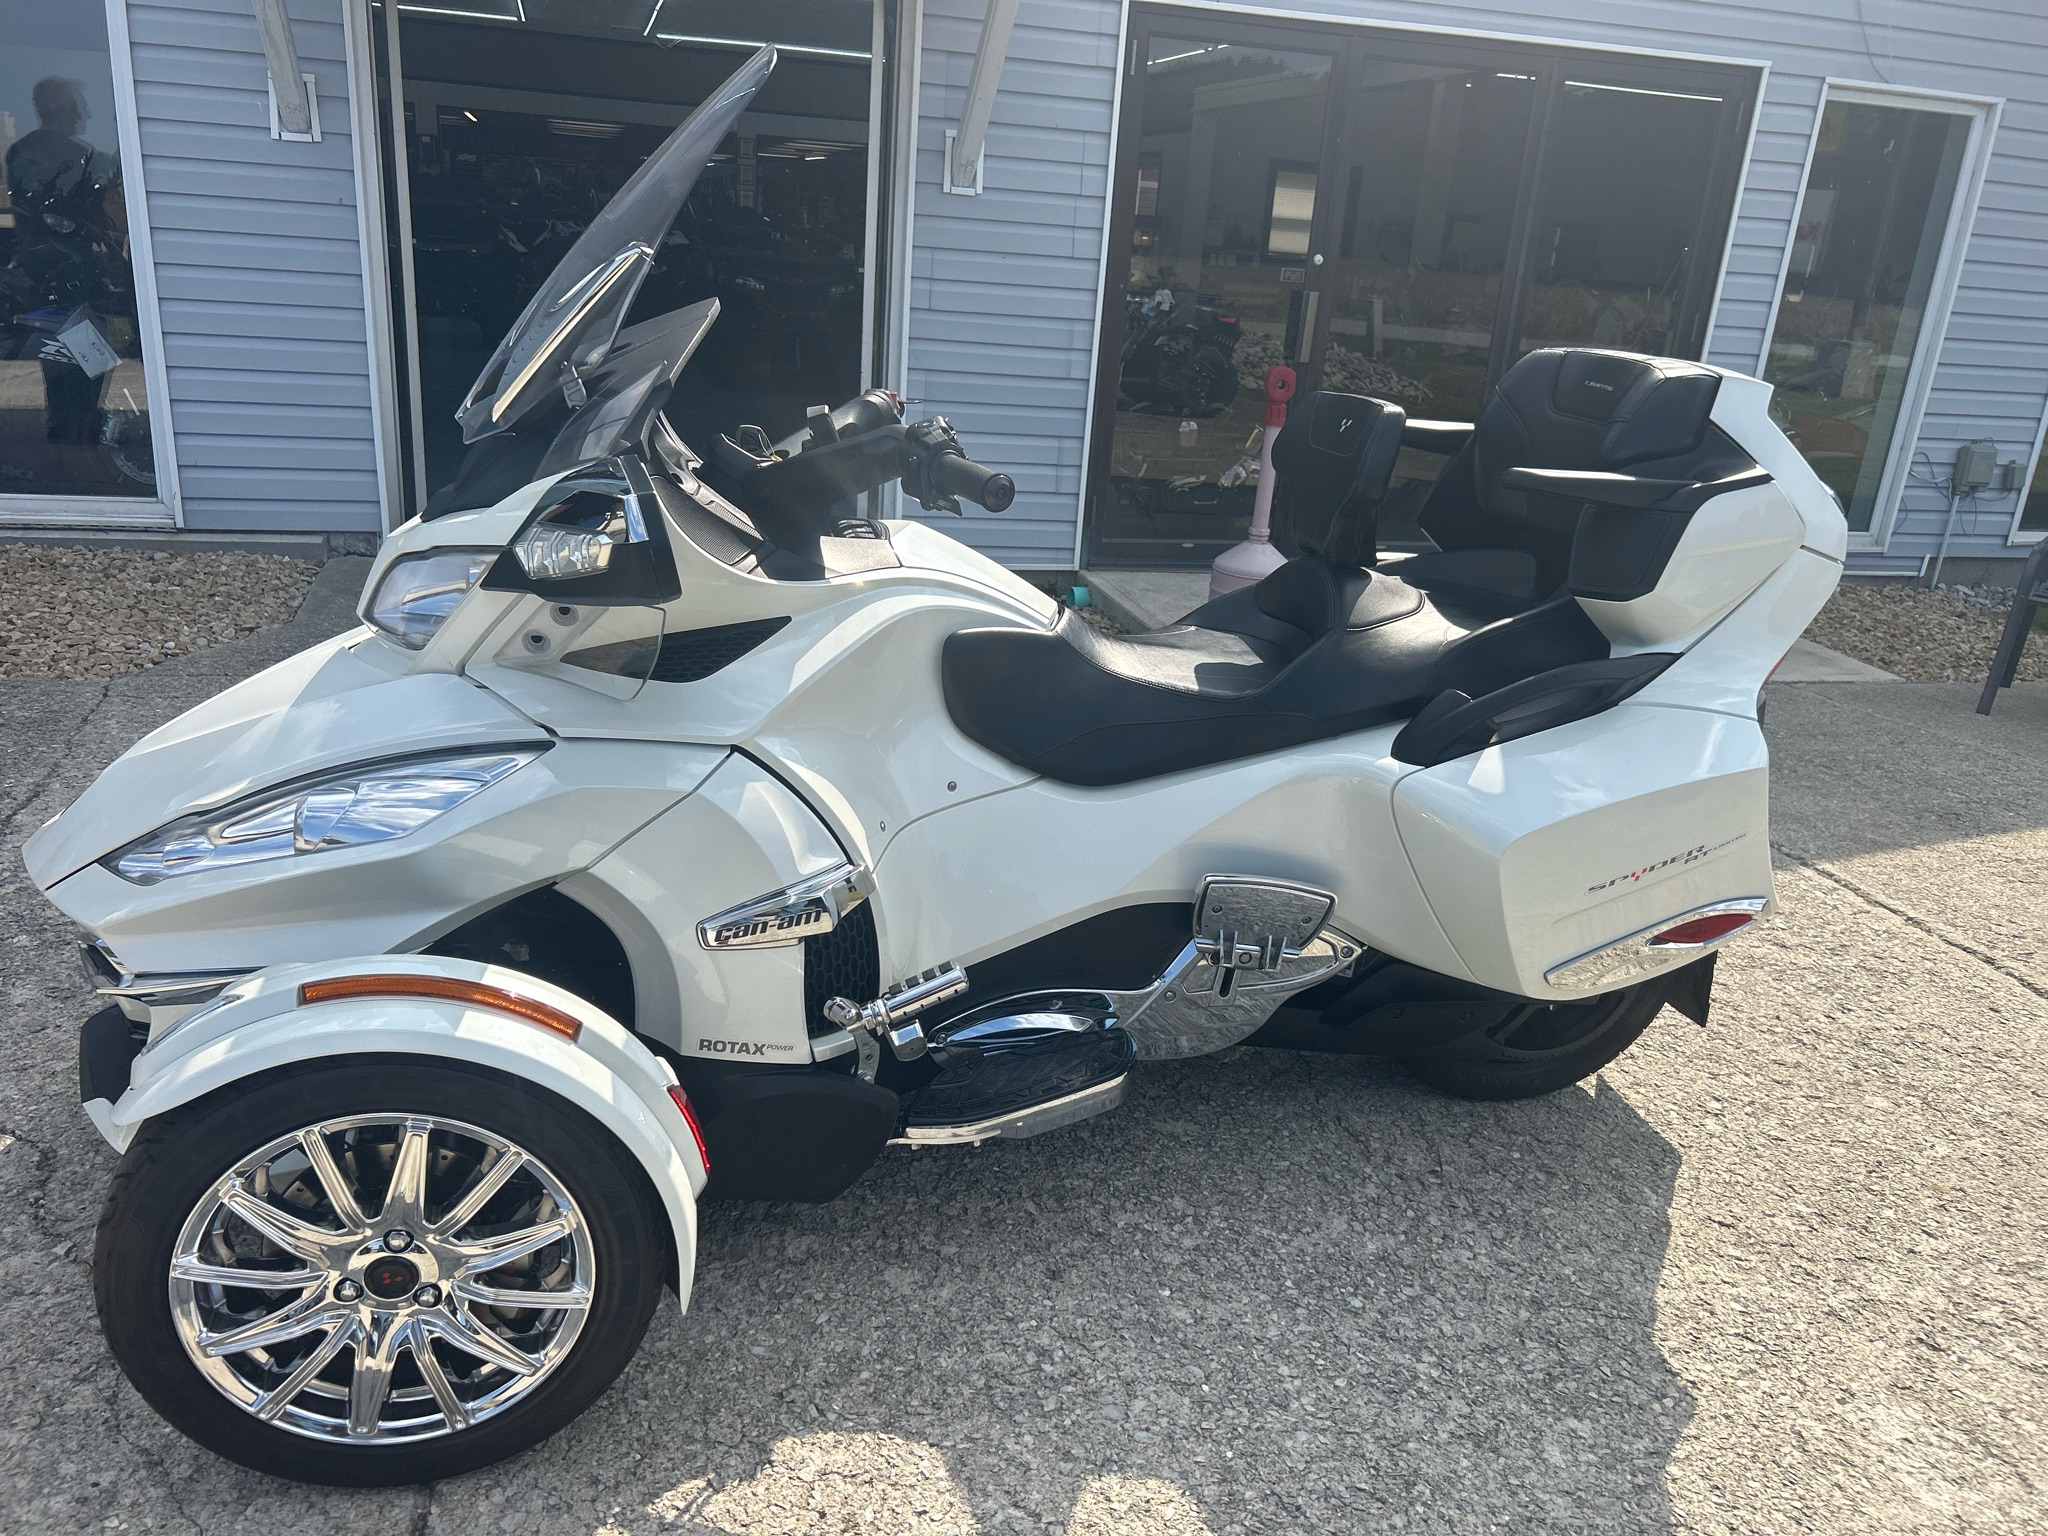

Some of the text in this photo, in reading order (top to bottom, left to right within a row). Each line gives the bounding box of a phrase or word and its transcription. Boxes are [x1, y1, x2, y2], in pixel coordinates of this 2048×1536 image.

[1285, 271, 1301, 280] Pull
[1584, 380, 1614, 391] LIMITED
[1684, 848, 1713, 865] RT
[1587, 845, 1706, 894] SPYDER
[699, 1039, 793, 1056] ROTAX POWER
